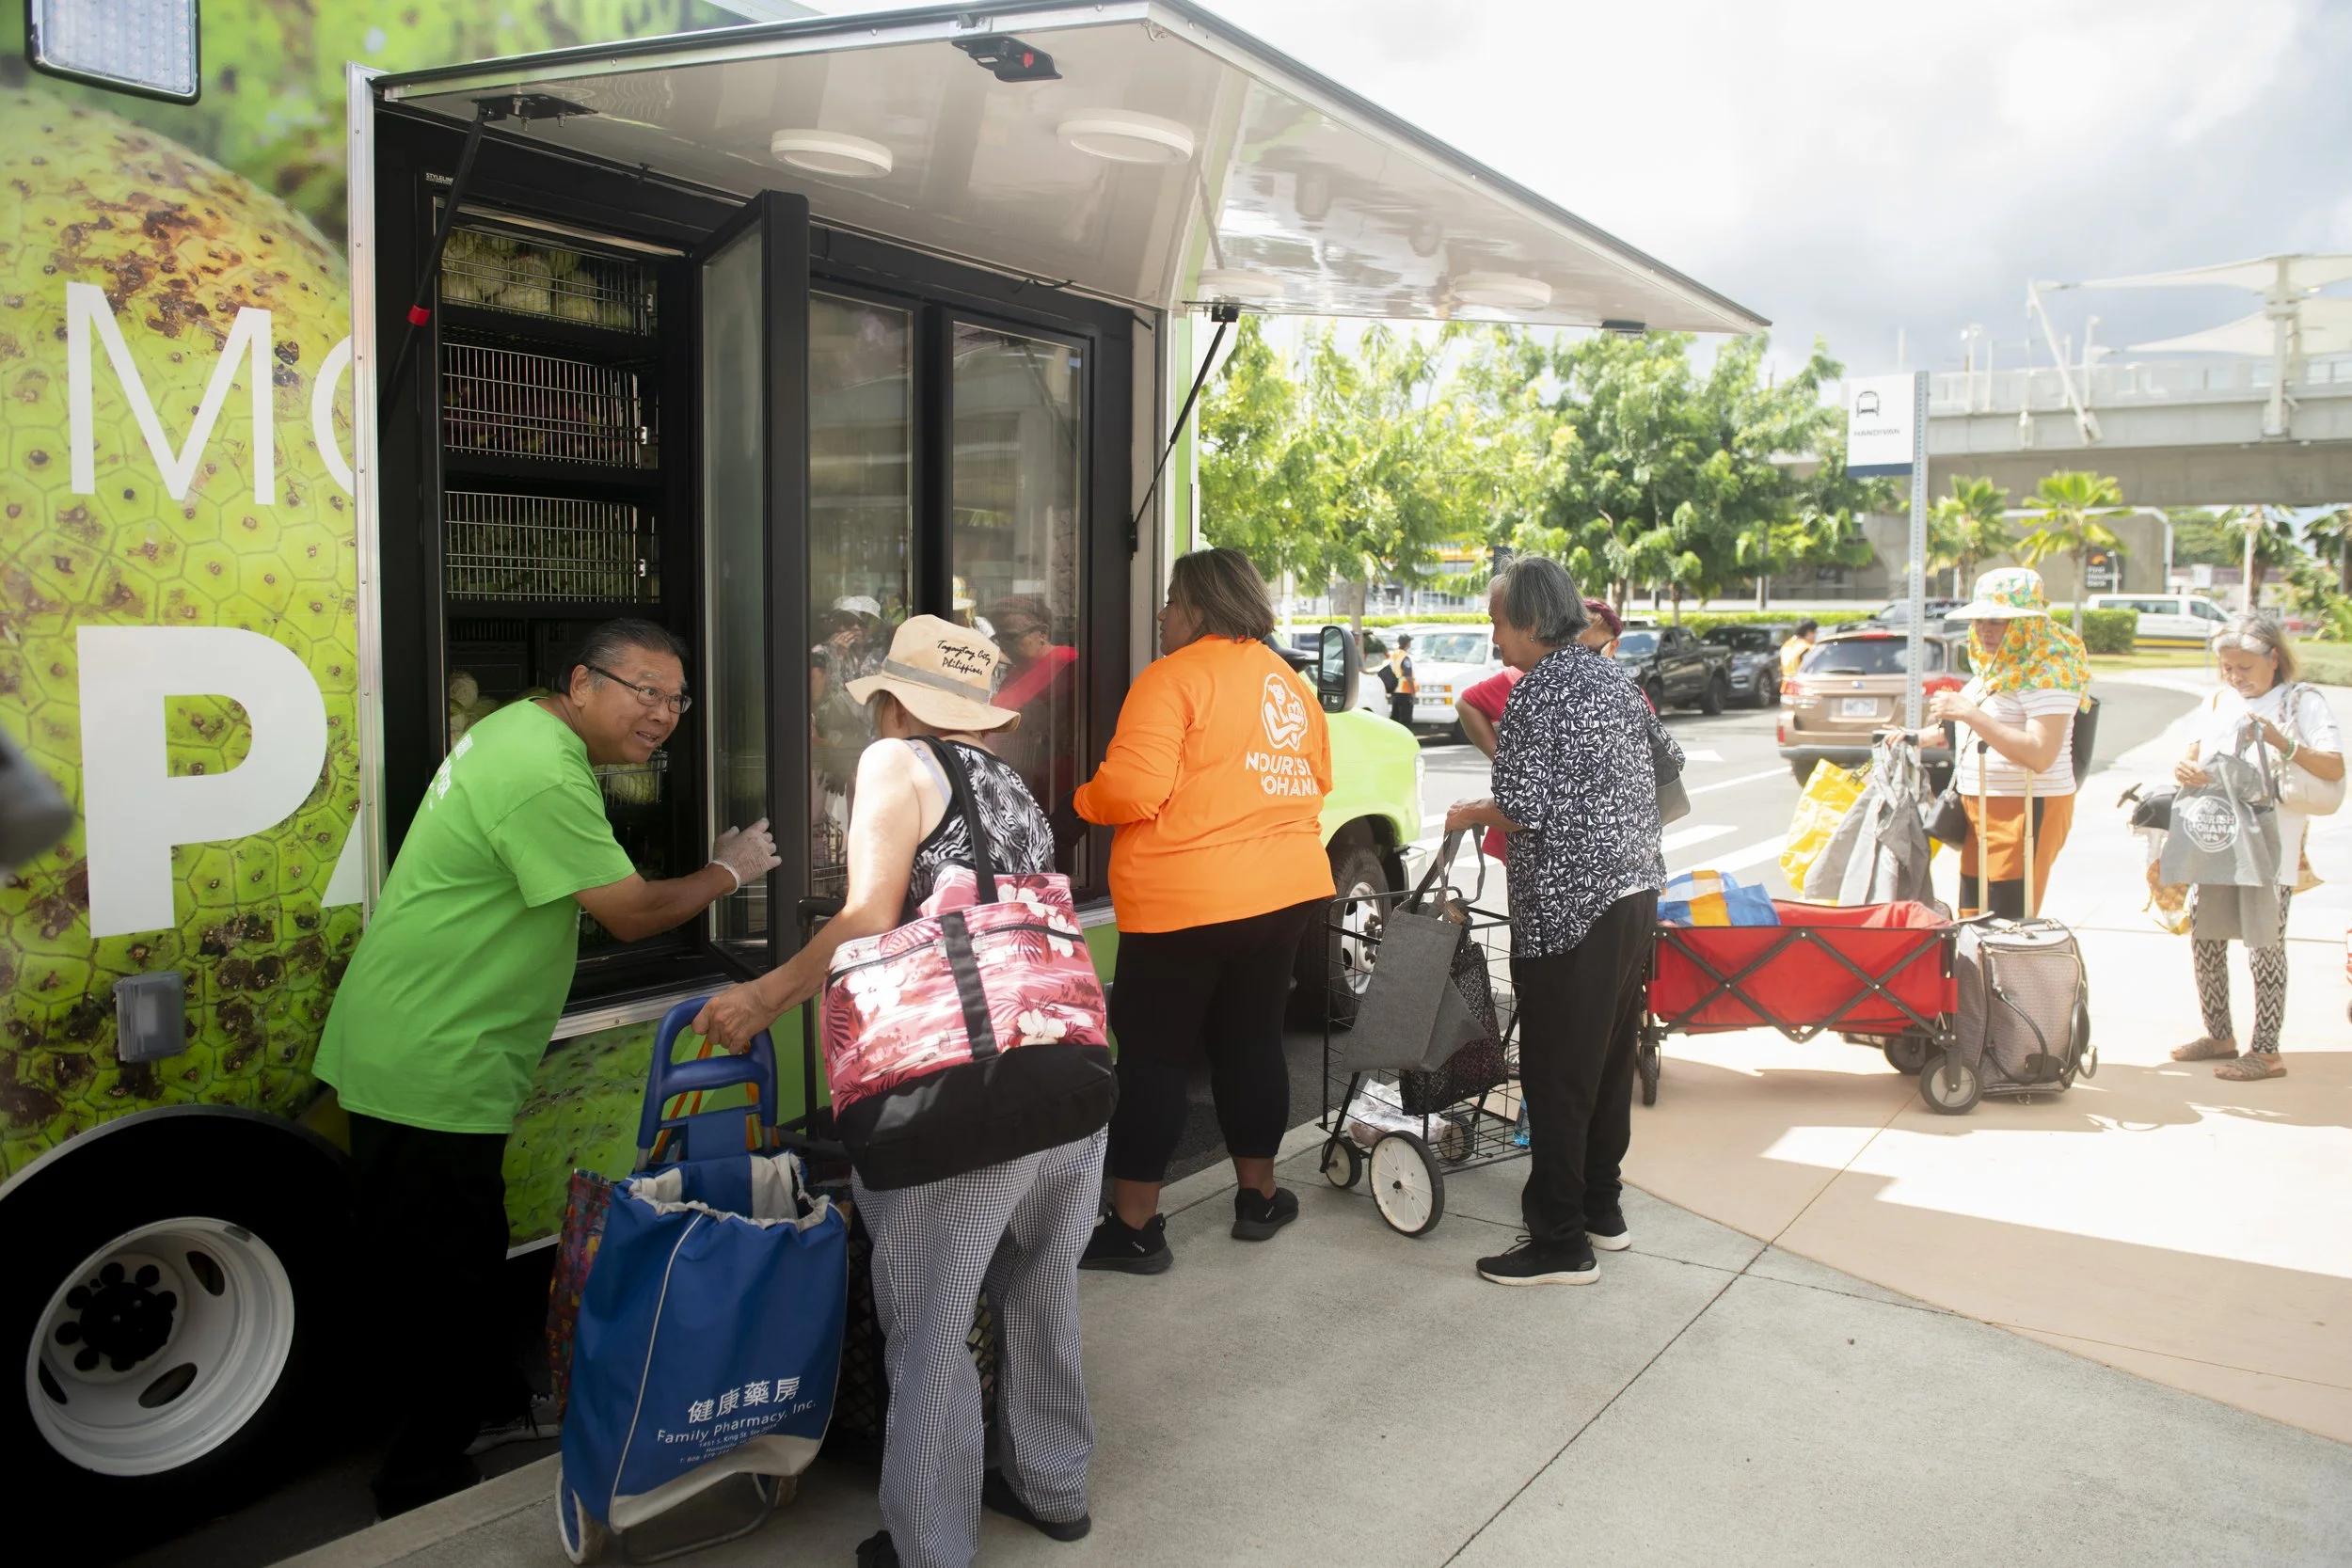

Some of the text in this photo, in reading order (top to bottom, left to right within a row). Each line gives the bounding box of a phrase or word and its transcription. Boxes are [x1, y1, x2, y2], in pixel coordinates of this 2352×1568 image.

[425, 172, 453, 183] STYLELIN
[67, 281, 354, 505] M
[942, 657, 982, 675] Philippines
[977, 650, 991, 666] City
[77, 626, 363, 939] P
[2193, 813, 2235, 825] OURISH
[688, 1376, 801, 1424] 健康藥房
[658, 1429, 709, 1444] Family
[792, 1400, 817, 1415] Inc.
